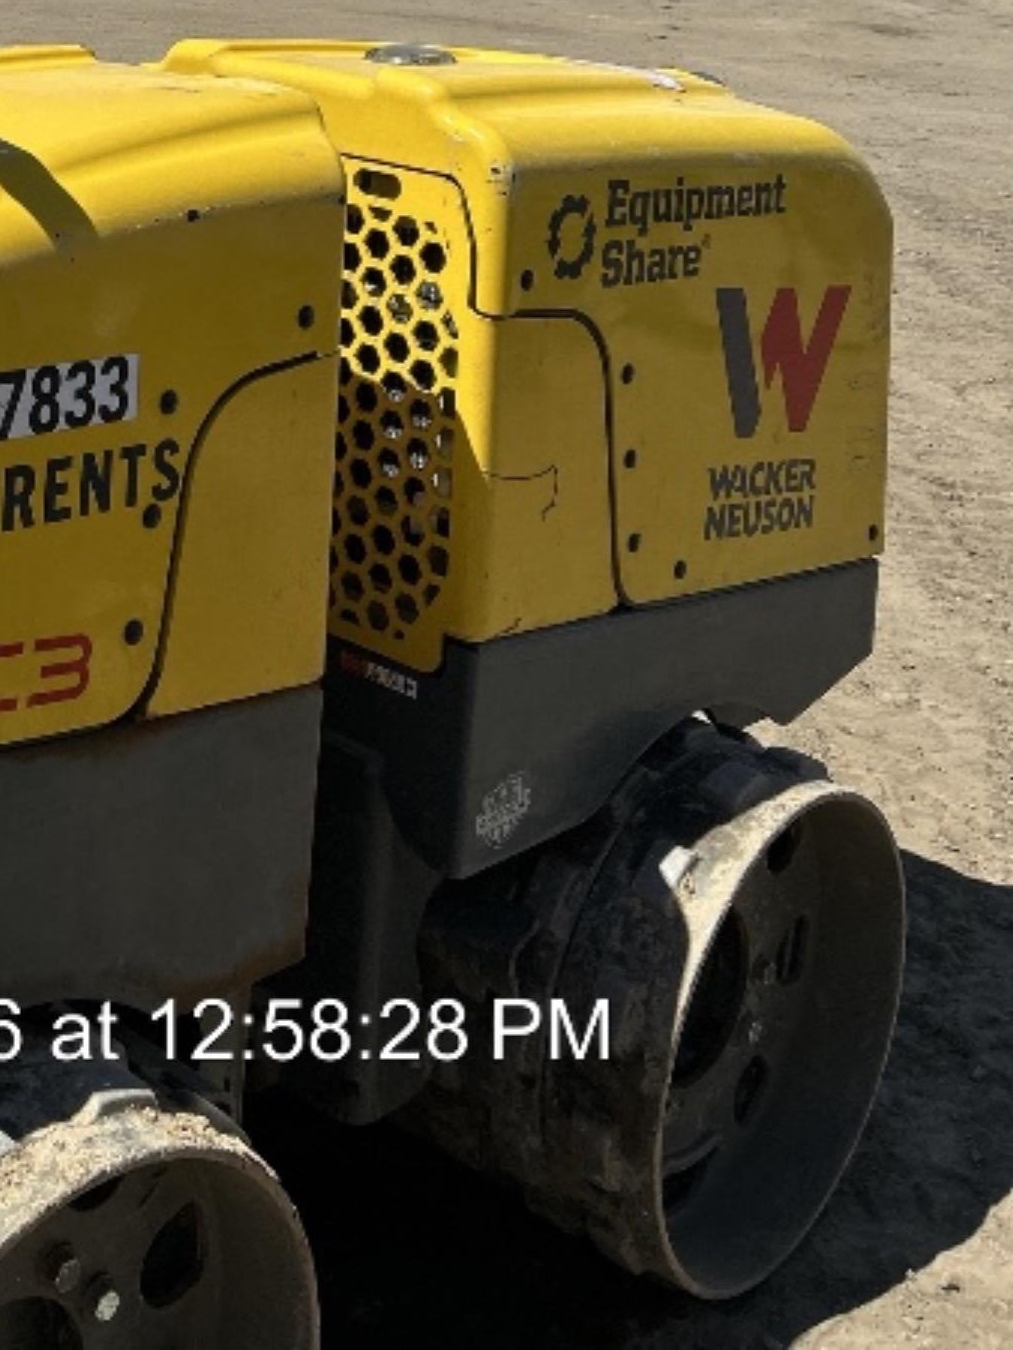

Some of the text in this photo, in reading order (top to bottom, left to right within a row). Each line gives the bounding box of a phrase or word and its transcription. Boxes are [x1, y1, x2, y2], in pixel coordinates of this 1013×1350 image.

[605, 174, 786, 235] Equipment
[708, 458, 816, 500] WACKER
[704, 495, 815, 540] NEUSON
